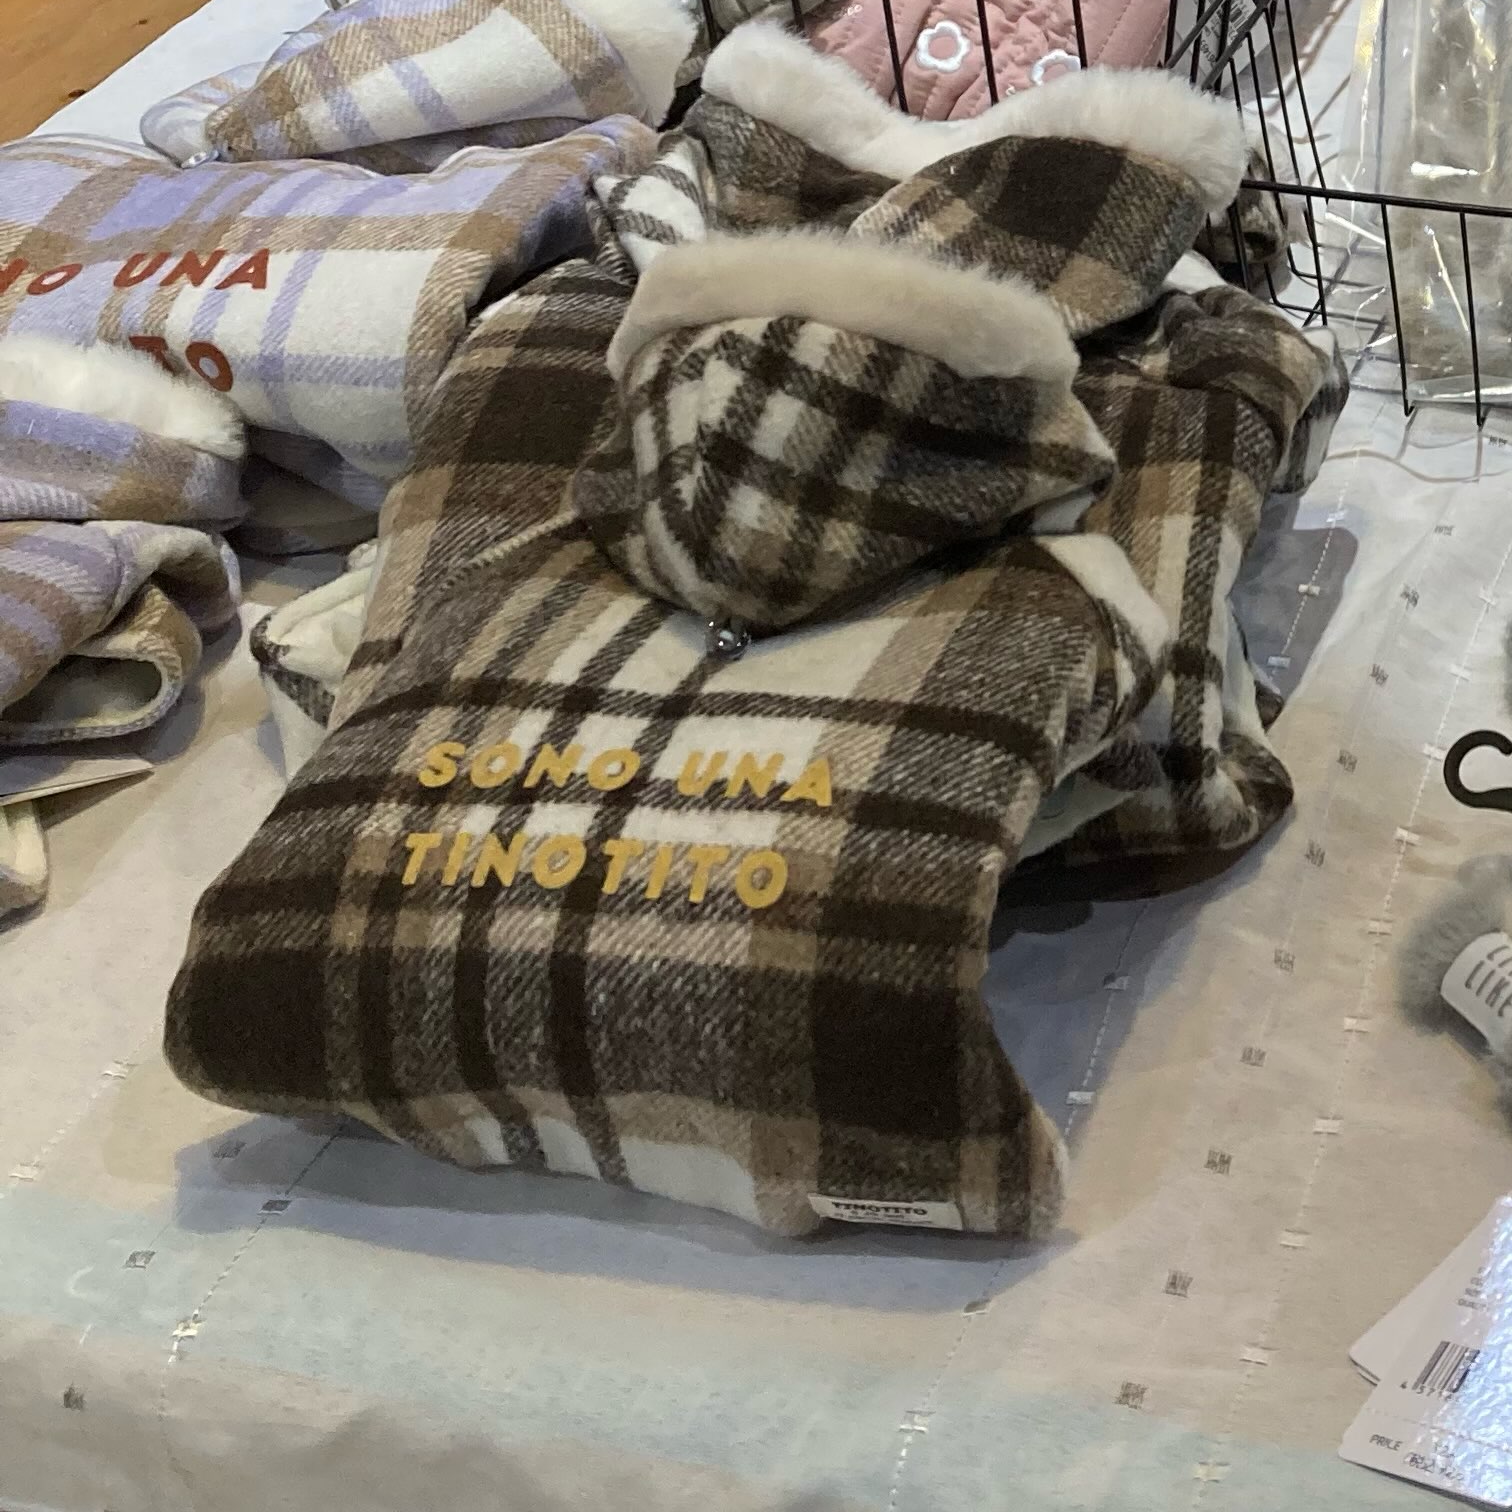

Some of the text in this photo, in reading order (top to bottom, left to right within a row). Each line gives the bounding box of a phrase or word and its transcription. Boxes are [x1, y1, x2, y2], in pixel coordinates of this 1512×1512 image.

[113, 248, 269, 290] UNA
[418, 741, 833, 807] SONO UNA
[1369, 1434, 1404, 1452] PRICE
